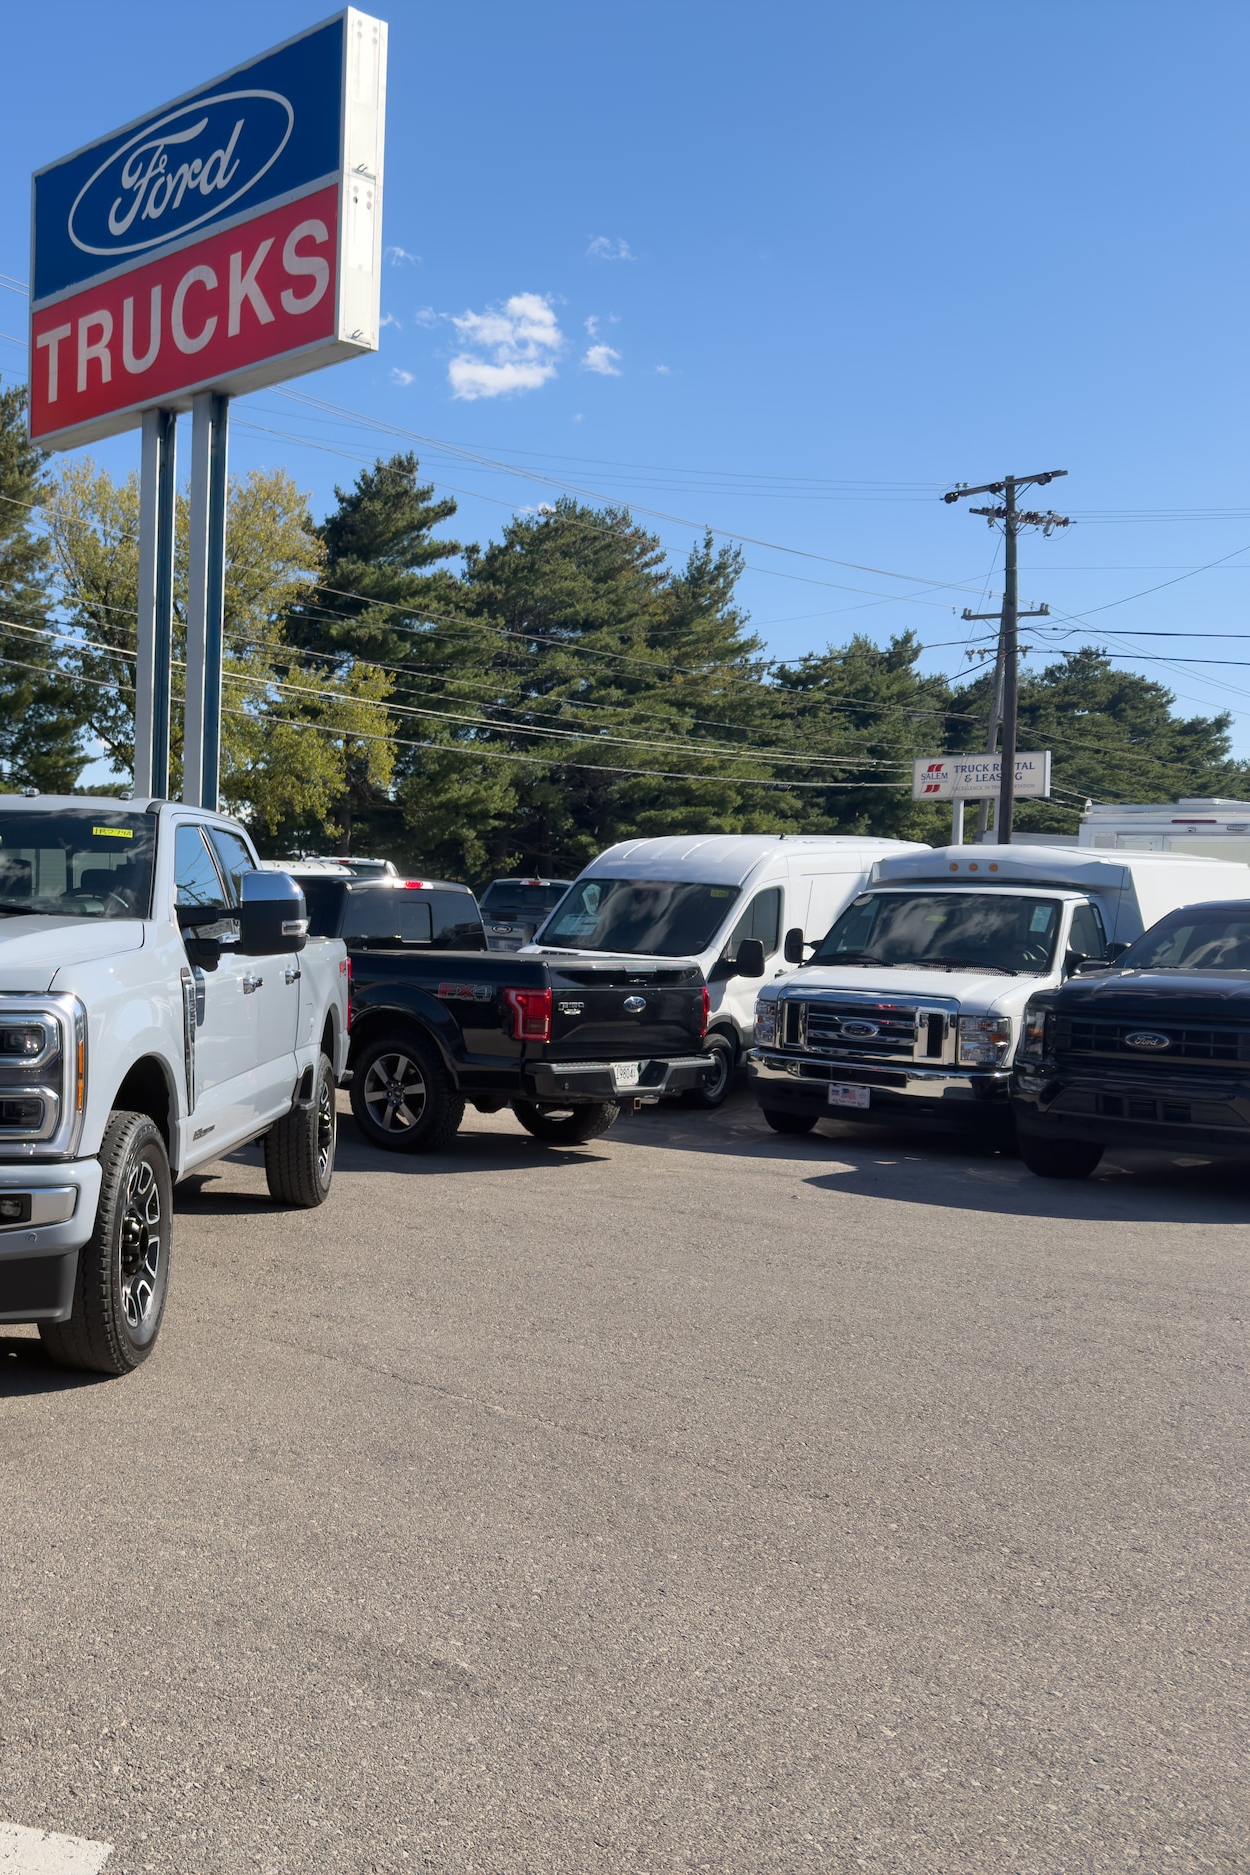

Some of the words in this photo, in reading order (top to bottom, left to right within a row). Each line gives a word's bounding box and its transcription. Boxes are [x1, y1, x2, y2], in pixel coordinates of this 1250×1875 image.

[108, 117, 245, 237] Ford
[36, 218, 330, 404] TRUCKS
[953, 763, 989, 774] TRUCK
[992, 761, 1036, 772] RTAL
[920, 772, 949, 780] SALEM
[964, 774, 973, 783] &
[975, 772, 1023, 783] LEASG
[437, 983, 492, 1001] FX4
[1134, 1035, 1159, 1046] Ford
